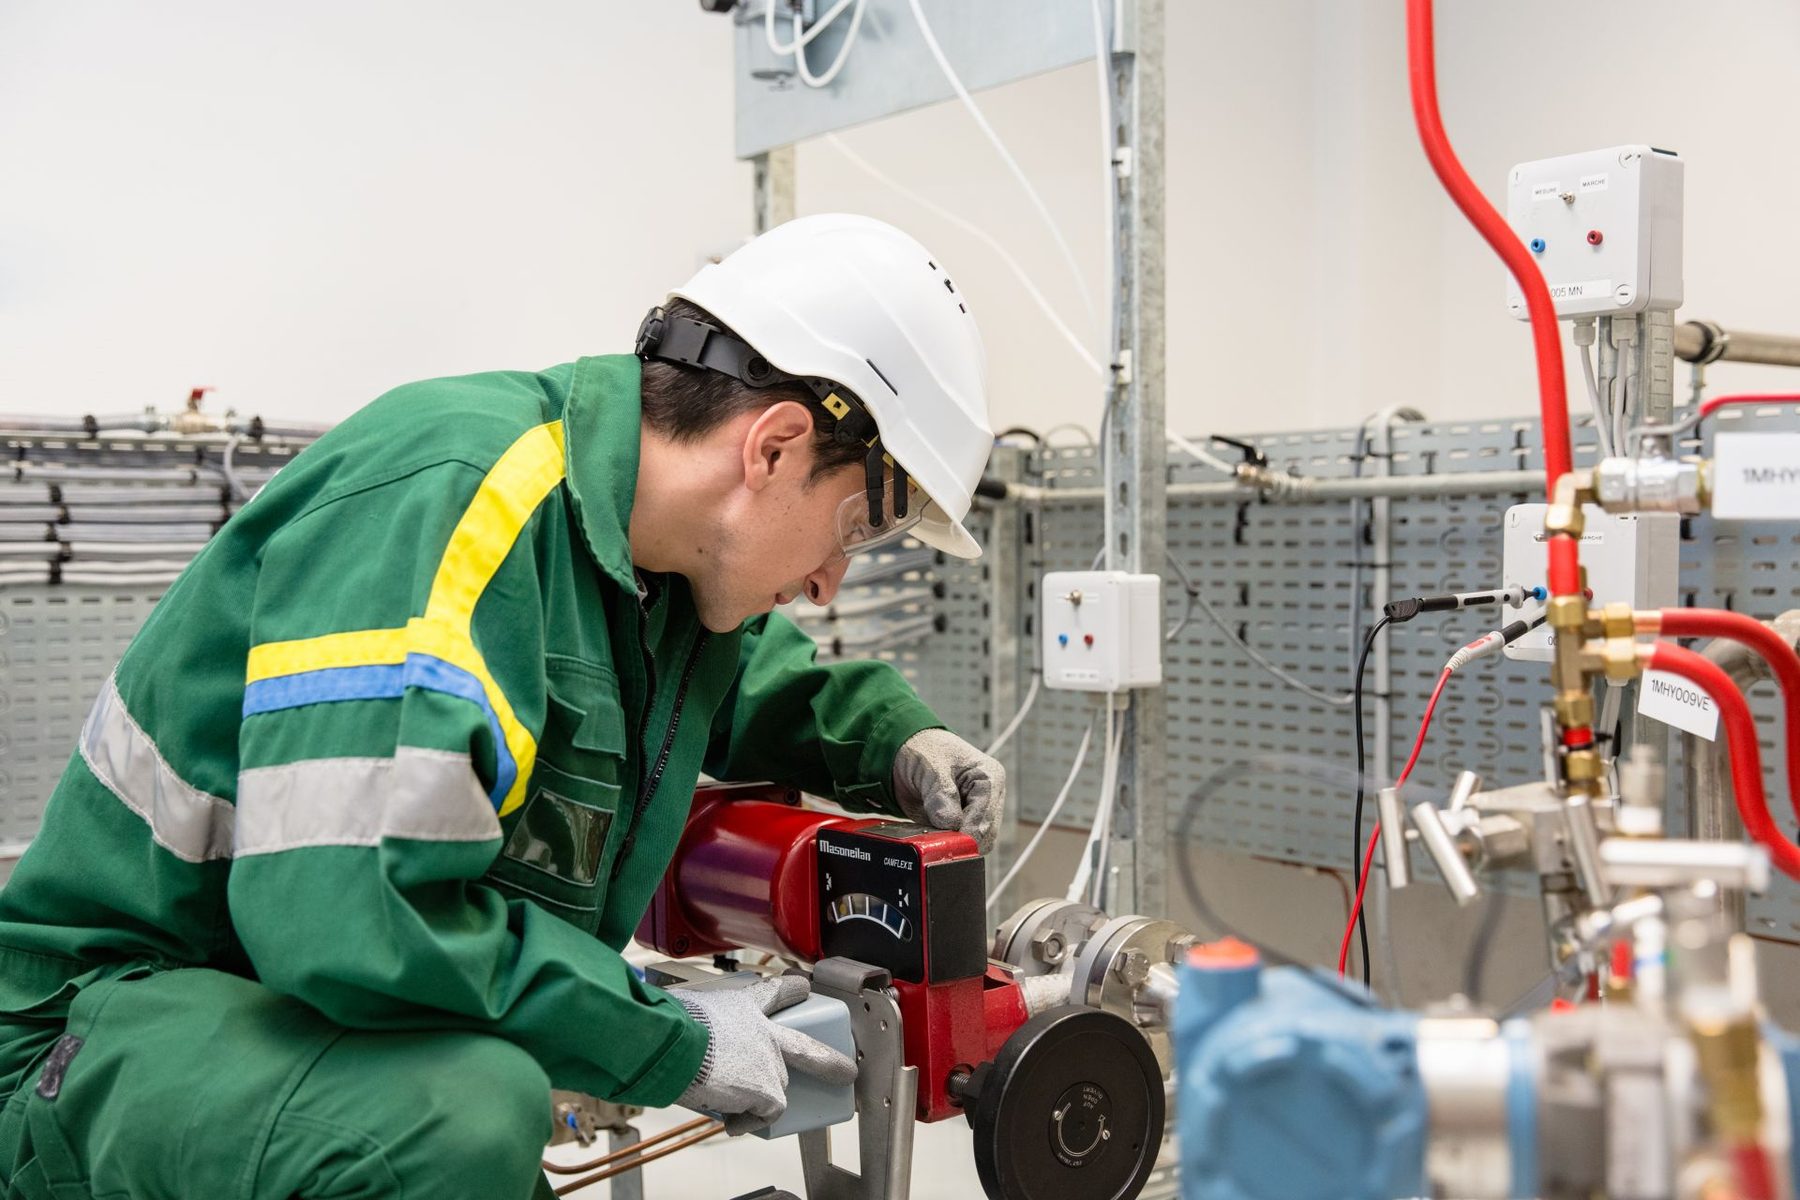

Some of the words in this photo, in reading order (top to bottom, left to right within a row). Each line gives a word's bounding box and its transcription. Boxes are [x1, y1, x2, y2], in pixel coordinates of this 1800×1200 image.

[1582, 178, 1606, 187] MARCHE
[1551, 287, 1567, 297] 005
[1568, 286, 1583, 296] MN
[1652, 678, 1710, 711] 1MHY009VE
[819, 840, 871, 861] Masoneilan
[884, 857, 908, 868] CAMFLEX
